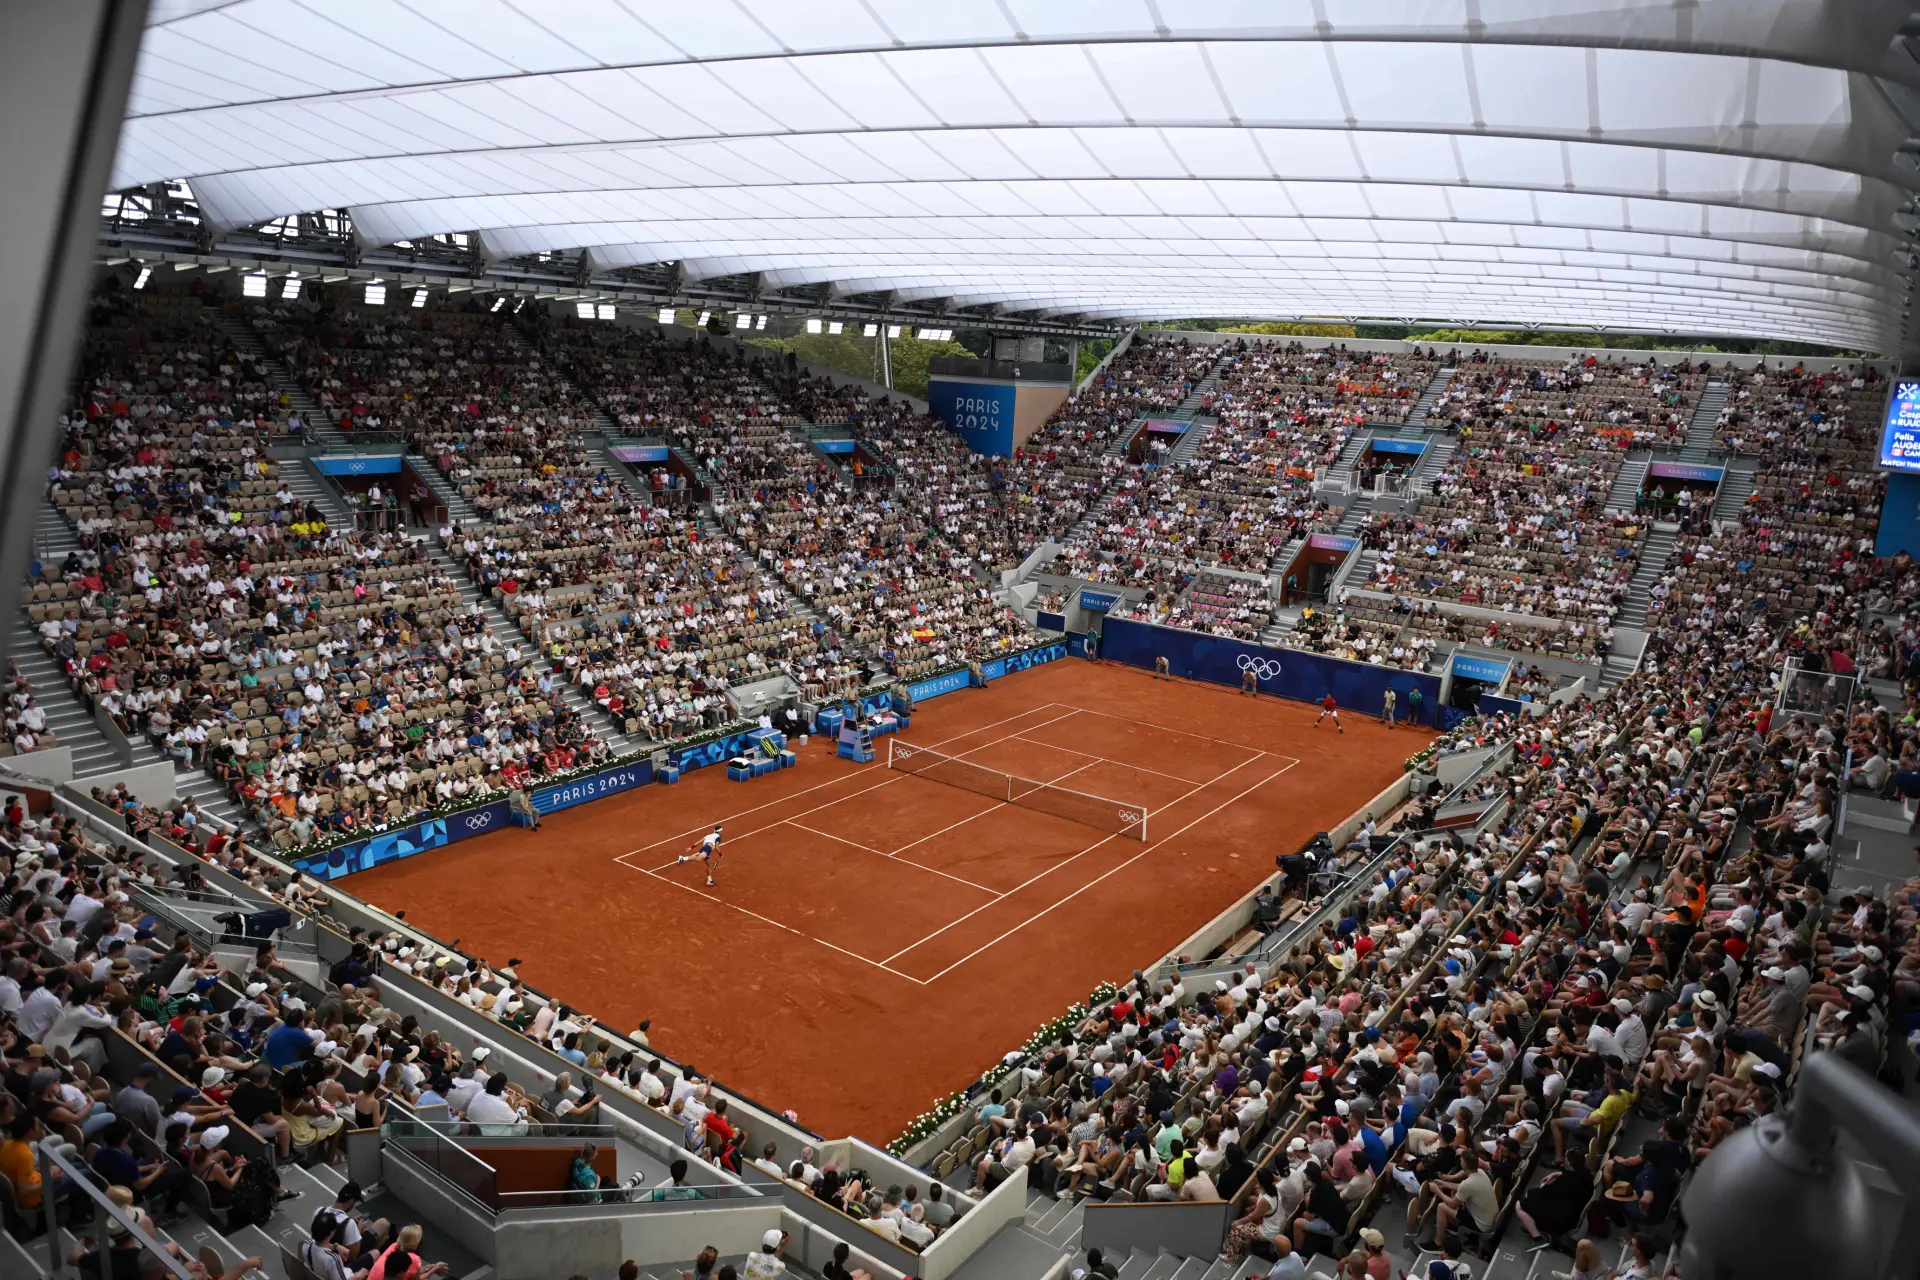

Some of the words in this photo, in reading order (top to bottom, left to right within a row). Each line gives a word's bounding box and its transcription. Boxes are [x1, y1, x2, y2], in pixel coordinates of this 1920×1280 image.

[955, 414, 999, 431] 2024
[939, 677, 959, 690] 2024
[599, 772, 635, 791] 2024
